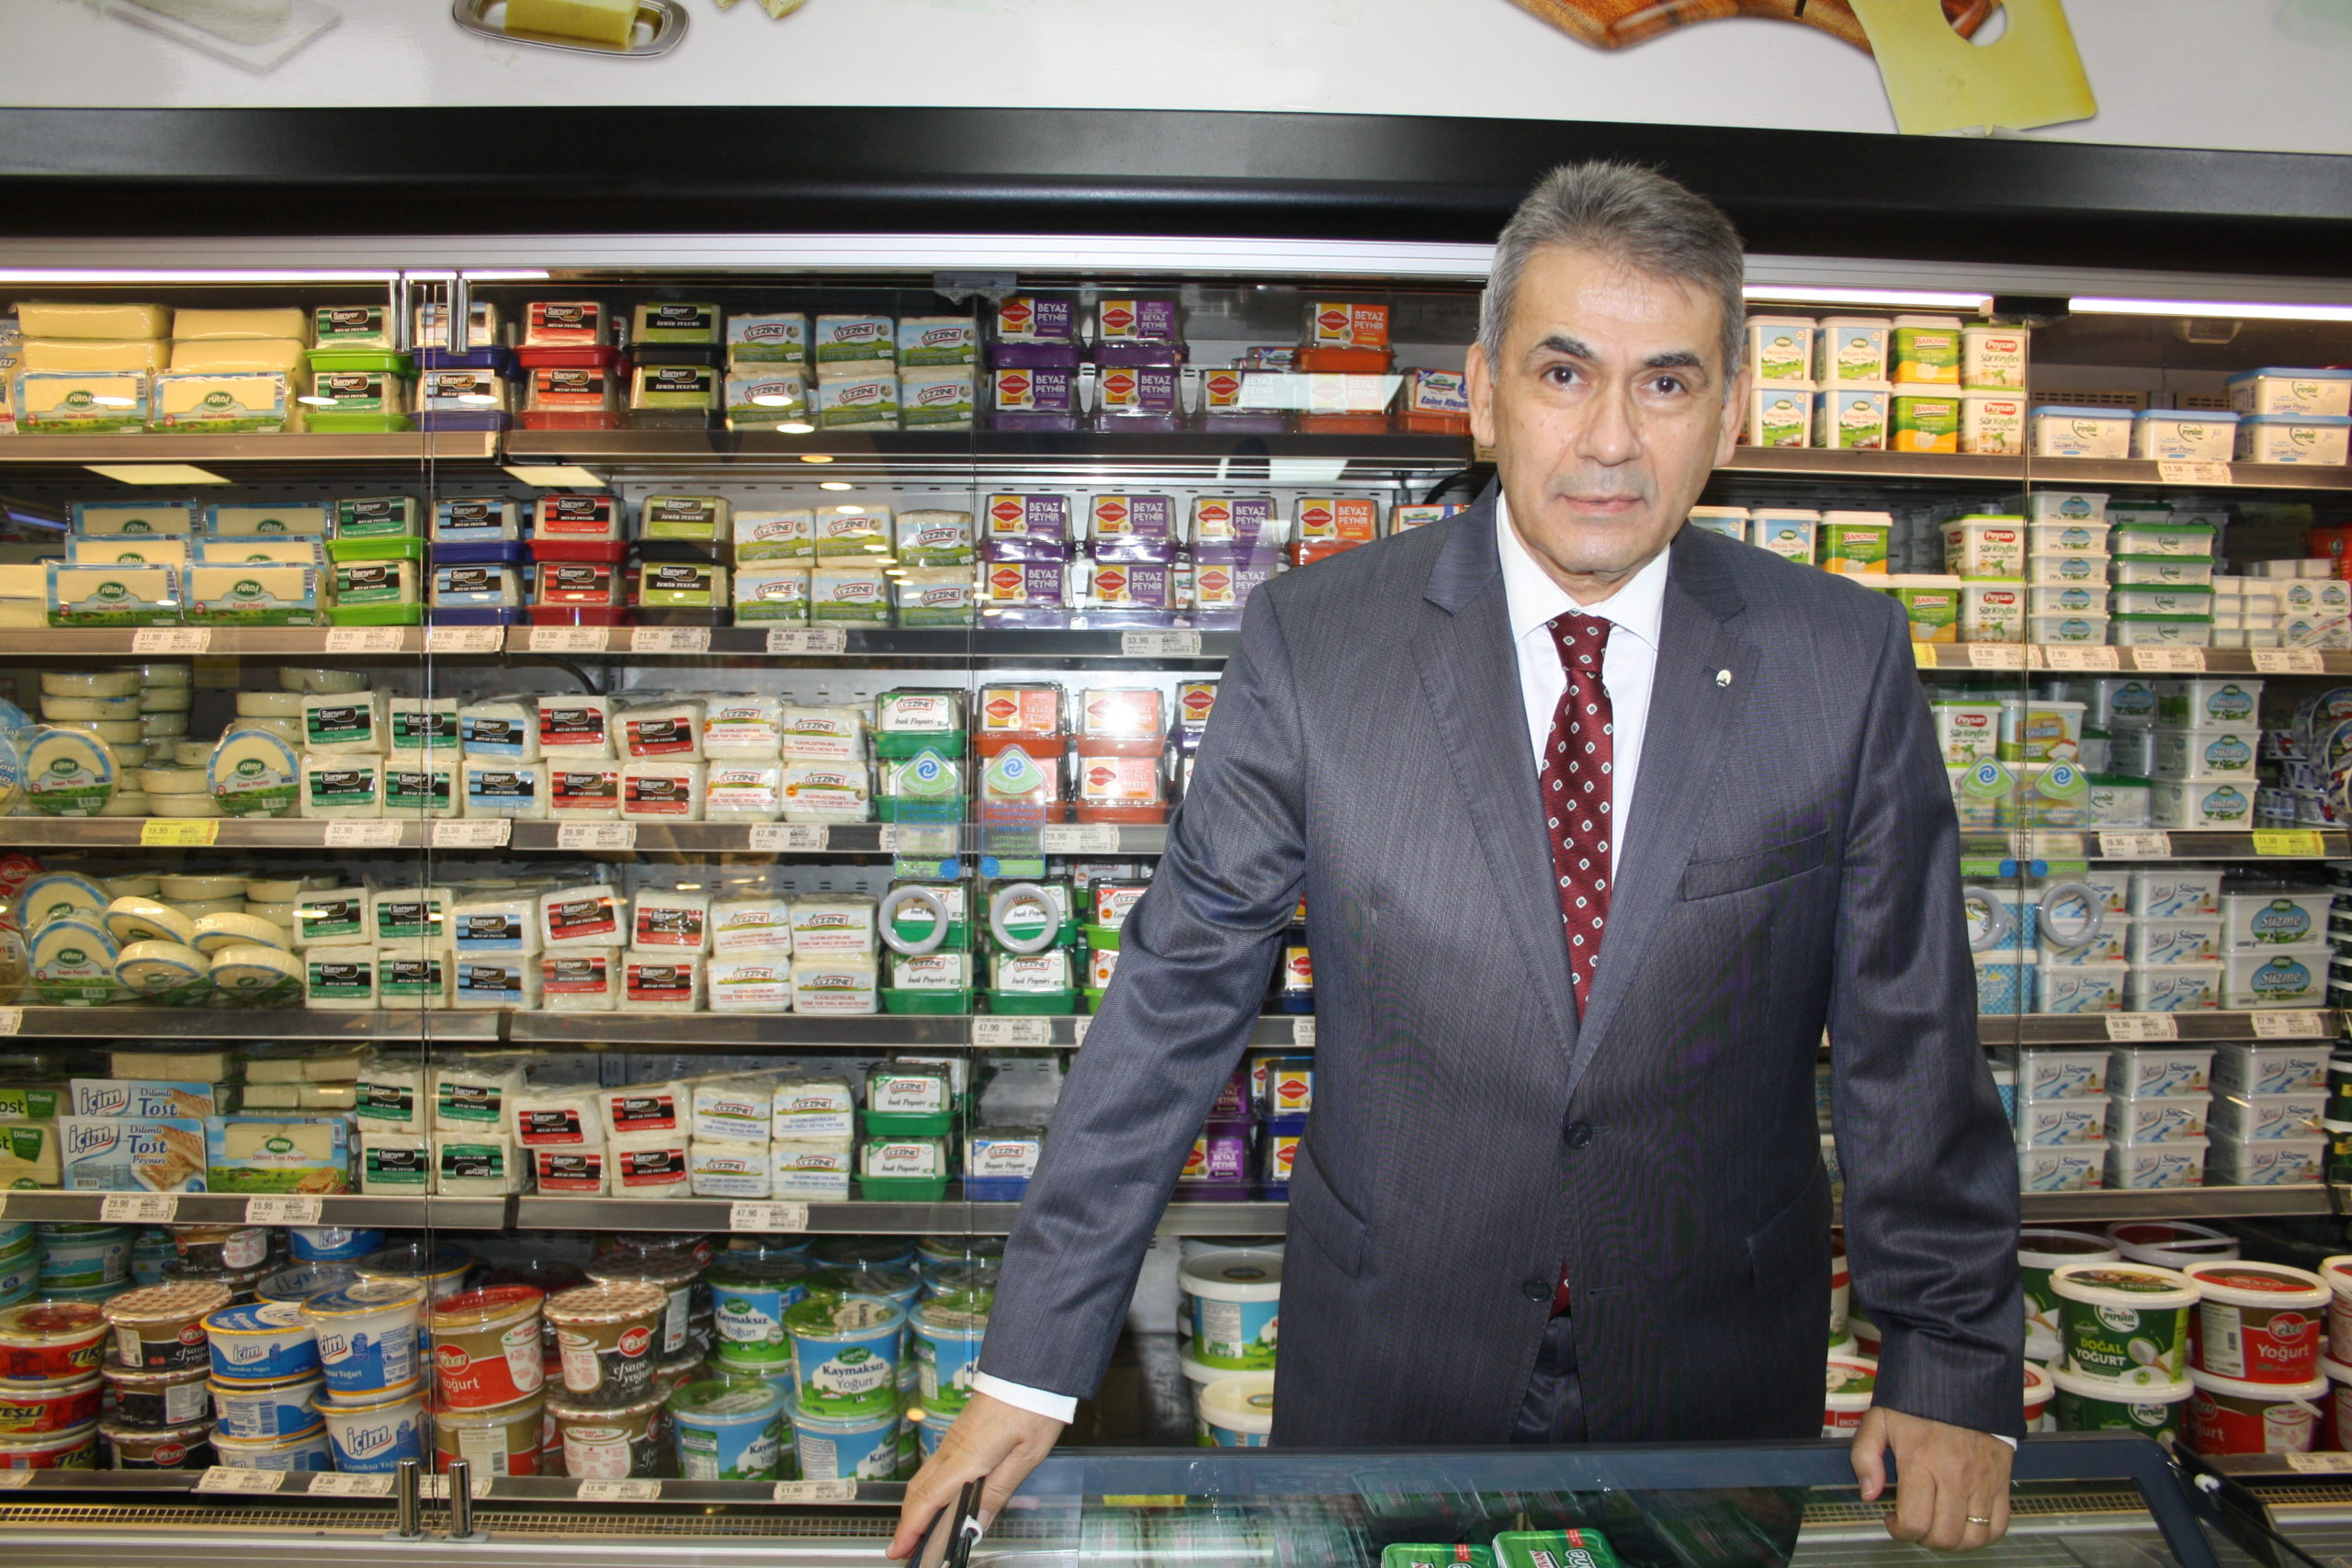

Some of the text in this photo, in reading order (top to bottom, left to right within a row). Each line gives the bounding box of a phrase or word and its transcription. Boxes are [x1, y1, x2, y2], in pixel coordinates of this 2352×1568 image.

[1037, 303, 1068, 314] BEYAZ
[1037, 311, 1067, 321] PEYNİR
[1354, 310, 1384, 321] BEYAZ
[1141, 321, 1167, 329] PEYNİR
[1354, 321, 1384, 331] PEYNİR
[1987, 341, 2015, 353] Peysan
[1035, 376, 1066, 384] BEYAZ
[1141, 376, 1171, 385] BEYAZ
[1035, 384, 1066, 393] PEYNİR
[1141, 384, 1170, 394] PEYNİR
[1986, 404, 2014, 414] Peysan
[1029, 502, 1059, 513] BEYAZ
[1133, 502, 1163, 513] BEYAZ
[1236, 506, 1266, 516] BEYAZ
[1339, 507, 1367, 516] BEYAZ
[1029, 512, 1059, 522] PEYNİR
[1133, 513, 1163, 522] PEYNİR
[1236, 514, 1265, 525] PEYNİR
[1339, 516, 1367, 525] PEYNİR
[1985, 531, 2015, 543] Peysan
[1028, 570, 1058, 580] BEYAZ
[1132, 571, 1161, 581] BEYAZ
[1236, 572, 1265, 581] BEYAZ
[1028, 579, 1057, 589] PEYNİR
[1132, 581, 1161, 591] PEYNİR
[1985, 592, 2014, 604] Peysan
[537, 631, 557, 639] 19.90
[1127, 637, 1148, 645] 33.90
[899, 698, 933, 710] LEZZİNE
[1957, 716, 1984, 726] Peysan
[564, 829, 584, 837] 39.90
[755, 829, 777, 838] 47.90
[2259, 914, 2301, 930] Süzme
[2259, 971, 2301, 986] Süzme
[978, 1023, 1000, 1032] 47.90
[140, 1088, 172, 1097] Dilimli
[28, 1094, 52, 1103] Dilimli
[139, 1098, 178, 1116] Tost
[130, 1125, 162, 1134] Dilimli
[14, 1131, 38, 1139] Dilimli
[127, 1135, 168, 1154] Tost
[132, 1155, 165, 1166] Peyniri
[107, 1199, 129, 1208] 29.90
[253, 1201, 273, 1210] 15.95
[736, 1209, 757, 1218] 47.90
[718, 1314, 768, 1325] Kaymaksız
[726, 1325, 756, 1338] Yoğurt
[2080, 1337, 2124, 1355] DOĞAL
[232, 1345, 262, 1363] İçim
[2075, 1348, 2126, 1365] YOĞURT
[2256, 1343, 2309, 1362] Yoğurt
[822, 1361, 885, 1376] Kaymaksız
[337, 1370, 362, 1380] Yoğurt
[440, 1376, 480, 1392] Yoğurt
[836, 1376, 874, 1390] Yoğurt
[347, 1425, 389, 1456] İçim
